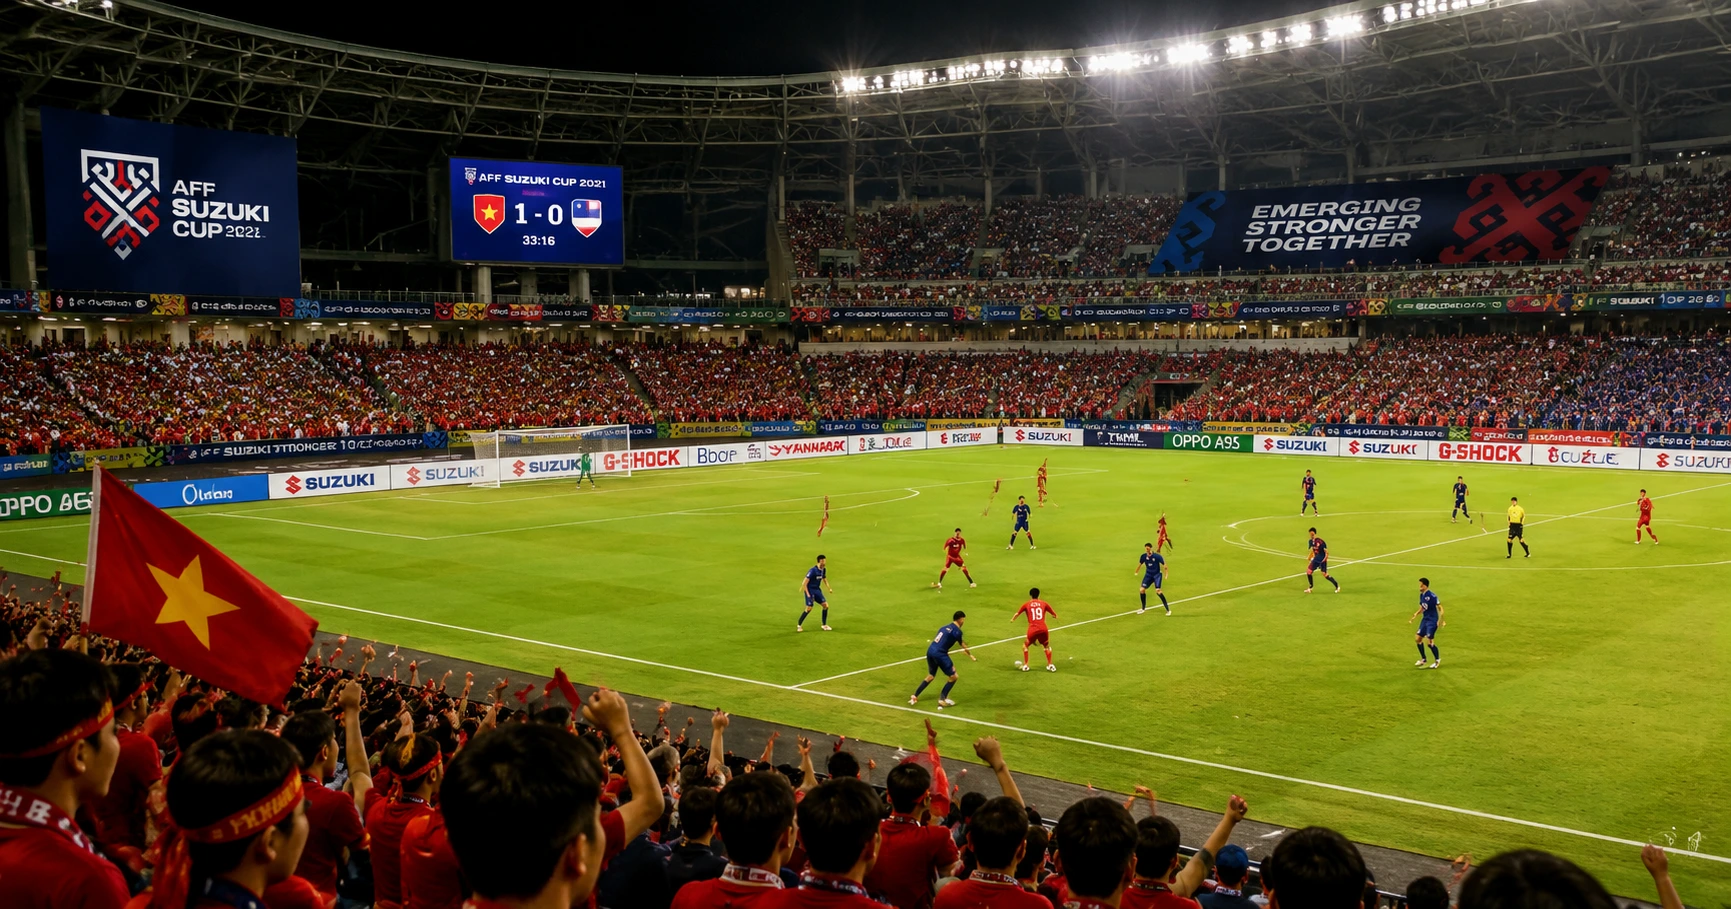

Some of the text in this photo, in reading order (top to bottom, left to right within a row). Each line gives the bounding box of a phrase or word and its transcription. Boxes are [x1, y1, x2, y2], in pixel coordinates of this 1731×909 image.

[479, 173, 606, 188] AFF SUZUKI CUP 2021
[172, 179, 270, 222] AFF SUZUKI
[1251, 197, 1422, 219] EMERGING
[515, 202, 528, 225] 1
[548, 204, 563, 225] 0
[172, 220, 223, 239] CUP
[1245, 214, 1422, 236] STRONGER
[522, 235, 556, 246] 33:16
[1242, 232, 1412, 253] TOGETHER
[1028, 431, 1072, 442] SUZUKI
[1172, 433, 1240, 449] OPPO A95
[1276, 439, 1327, 452] SUZUKI
[603, 449, 681, 471] G-SHOCK
[1438, 443, 1522, 462] G-SHOCK
[529, 458, 582, 473] SUZUK
[305, 473, 375, 490] SUZUKI
[1030, 607, 1043, 621] 19
